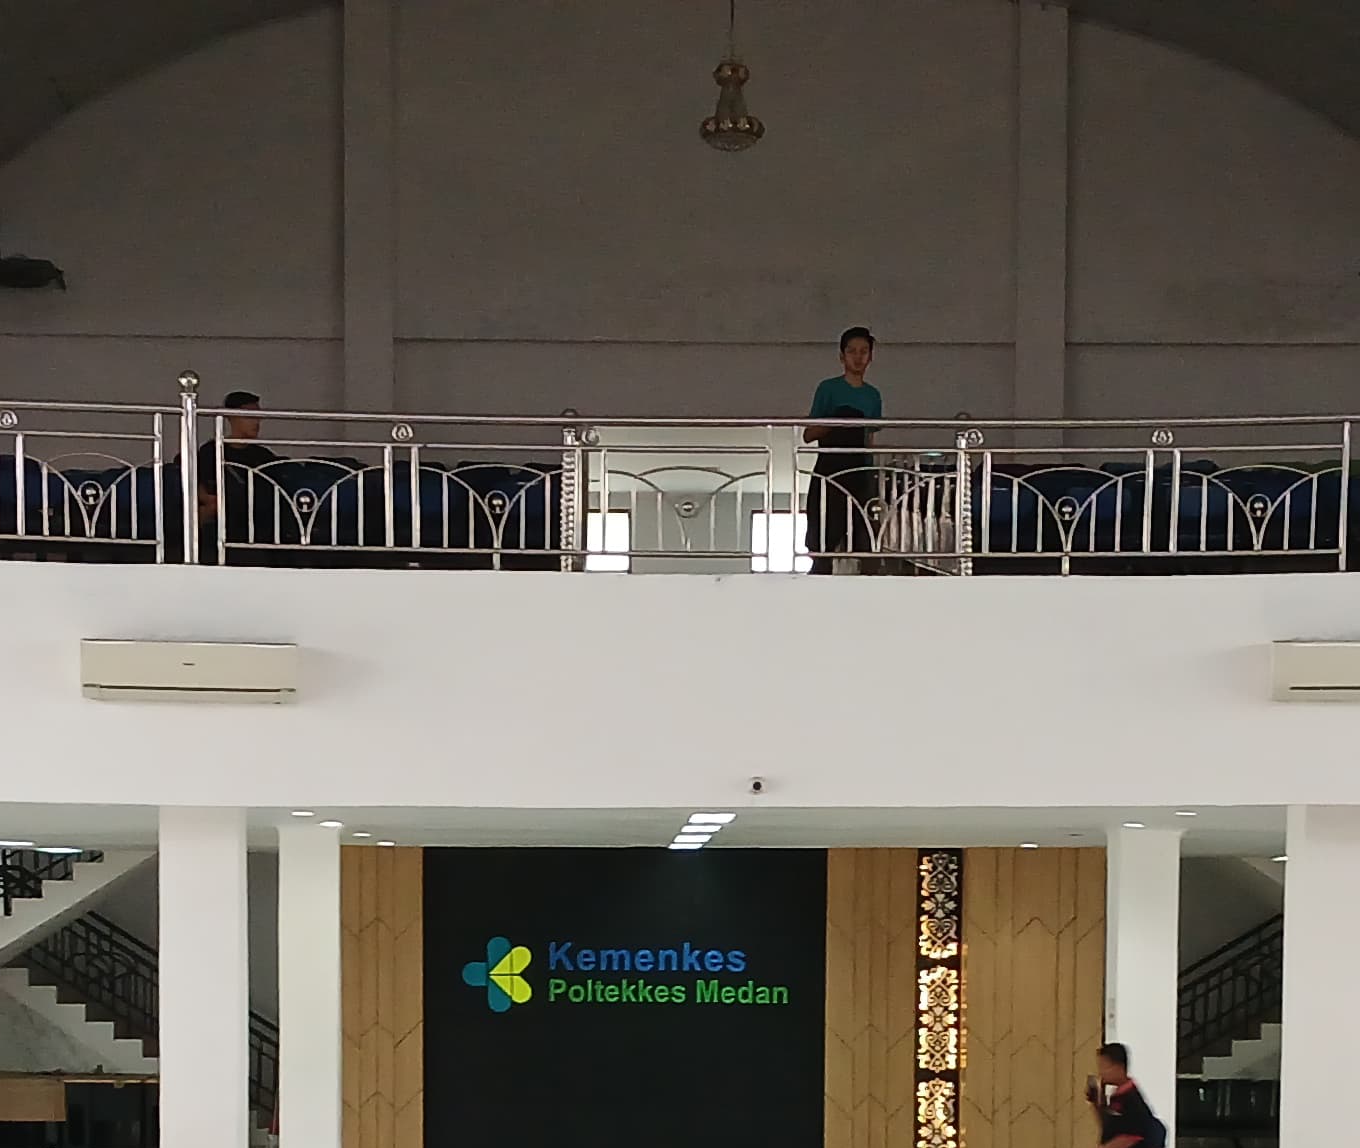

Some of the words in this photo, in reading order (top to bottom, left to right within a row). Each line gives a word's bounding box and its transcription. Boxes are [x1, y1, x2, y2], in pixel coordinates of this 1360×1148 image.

[548, 941, 747, 972] Kemenkes
[549, 979, 686, 1003] Poltekkes
[696, 980, 789, 1005] Medan
